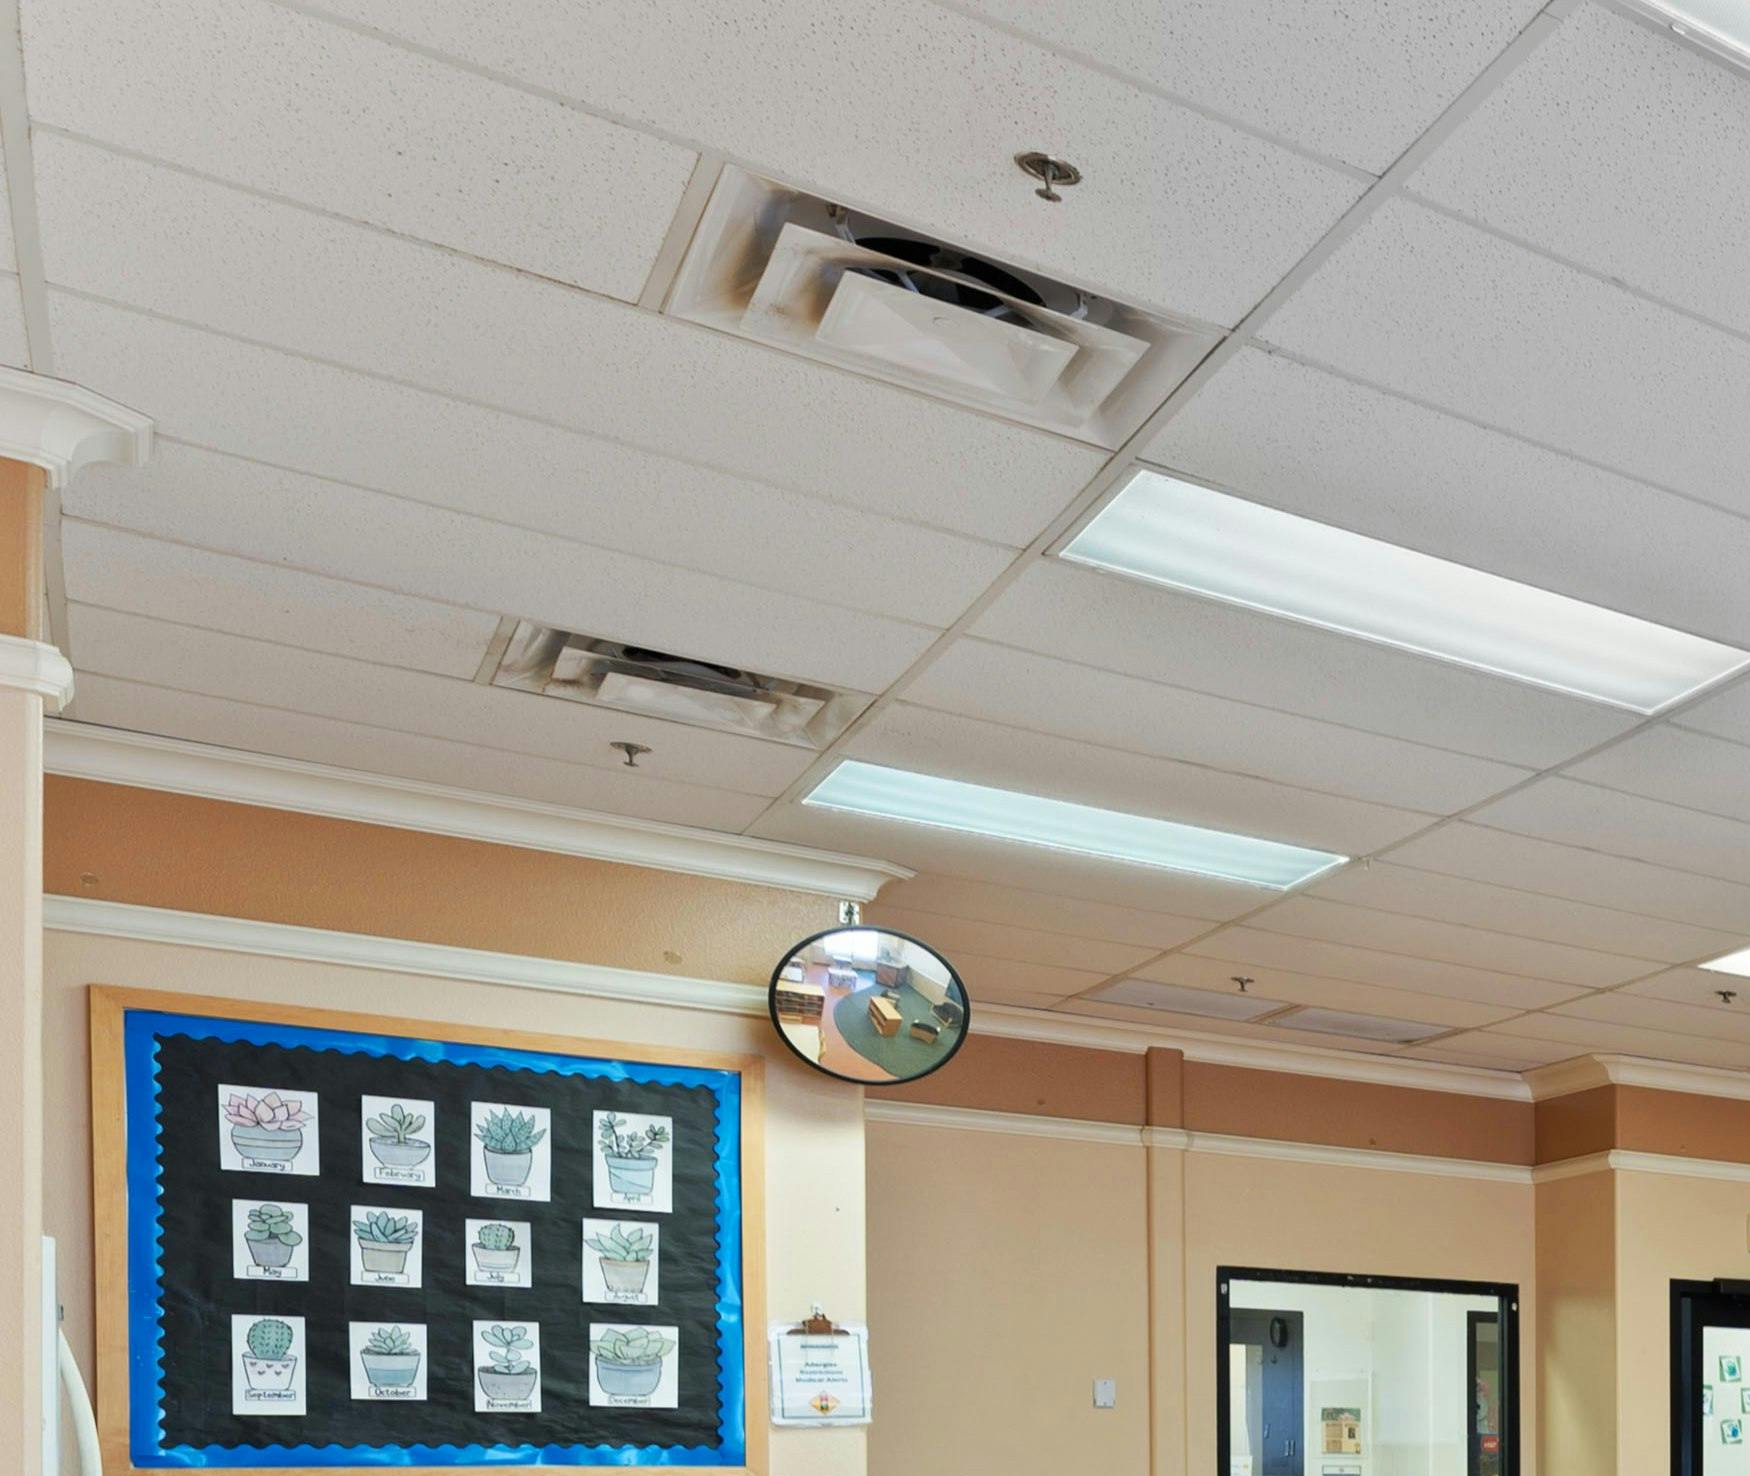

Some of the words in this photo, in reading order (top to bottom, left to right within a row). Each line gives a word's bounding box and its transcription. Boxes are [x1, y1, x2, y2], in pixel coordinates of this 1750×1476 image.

[248, 1158, 286, 1171] January
[379, 1168, 421, 1181] February
[497, 1186, 521, 1196] March
[263, 1267, 282, 1278] May
[374, 1389, 410, 1397] October
